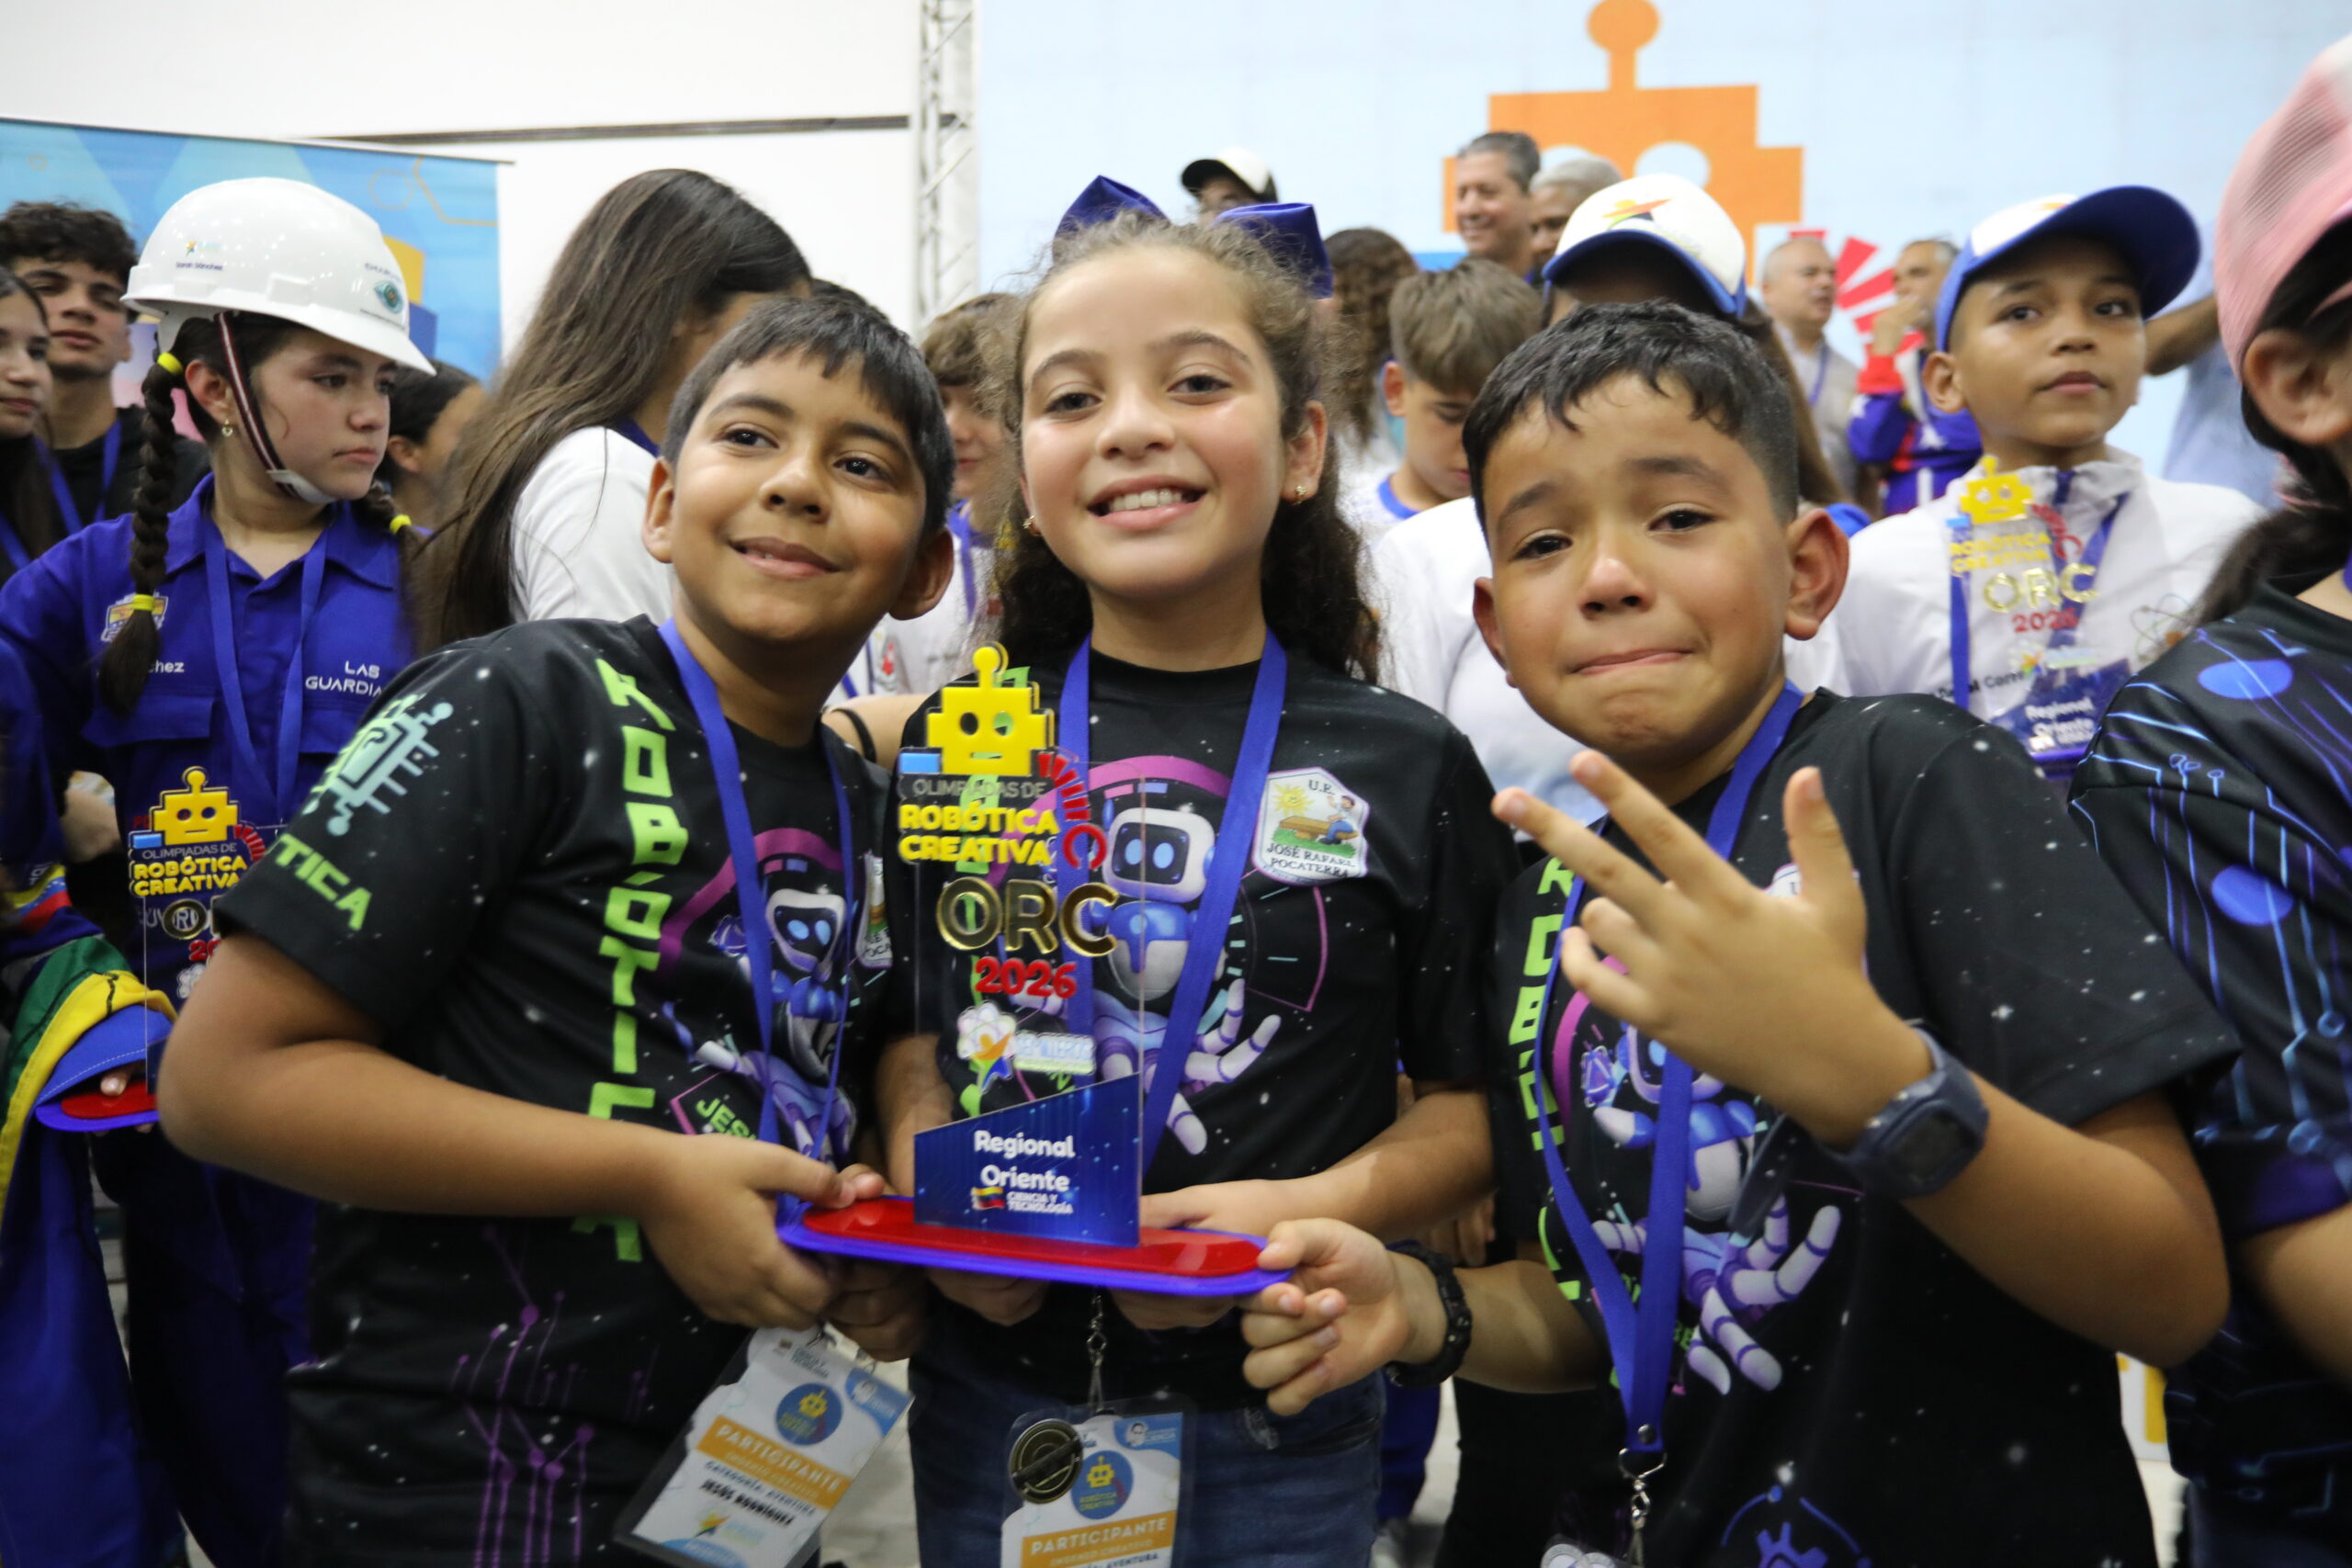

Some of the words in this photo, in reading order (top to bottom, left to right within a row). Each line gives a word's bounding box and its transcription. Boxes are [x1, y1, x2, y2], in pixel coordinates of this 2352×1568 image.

[1949, 531, 2053, 557] ROBÓTICA
[1951, 548, 2050, 572] CREATIVA
[1984, 562, 2099, 613] ORC
[345, 660, 380, 680] LAS
[913, 778, 1019, 798] OLIMPIADAS
[1021, 781, 1046, 799] DE
[899, 800, 1060, 835] ROBÓTICA
[141, 845, 218, 860] OLIMPIADAS
[220, 842, 237, 854] DE
[899, 835, 1053, 866] CREATIVA
[1304, 850, 1356, 868] RAFAEL
[133, 855, 247, 880] ROBÓTICA
[1271, 857, 1349, 878] POCATERRA
[132, 872, 241, 897] CREATIVA
[936, 876, 1120, 957] ORC
[974, 956, 1079, 999] 2026
[974, 1130, 1076, 1159] Regional
[980, 1164, 1070, 1192] Oriente
[716, 1424, 843, 1492] PARTICIPANTE
[1031, 1517, 1168, 1555] PARTICIPANTE
